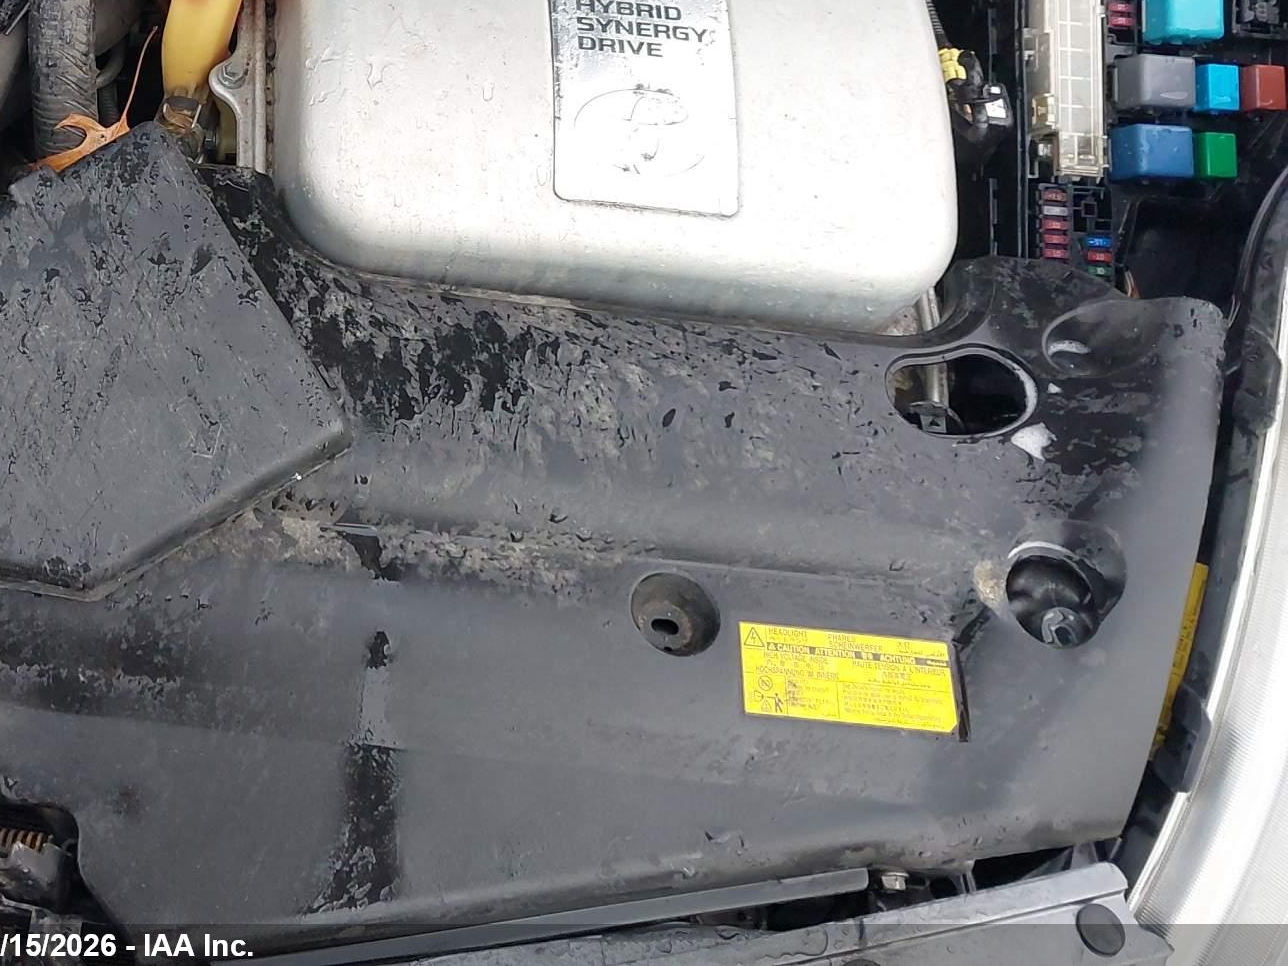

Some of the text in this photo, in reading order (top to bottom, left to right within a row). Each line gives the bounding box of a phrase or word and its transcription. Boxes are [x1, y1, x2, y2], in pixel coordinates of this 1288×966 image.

[576, 16, 708, 42] SYNERGY
[577, 36, 663, 57] DRIVE
[777, 643, 809, 654] CAUTION
[815, 648, 855, 659] ATTENTION
[880, 654, 915, 665] ACHTUNG
